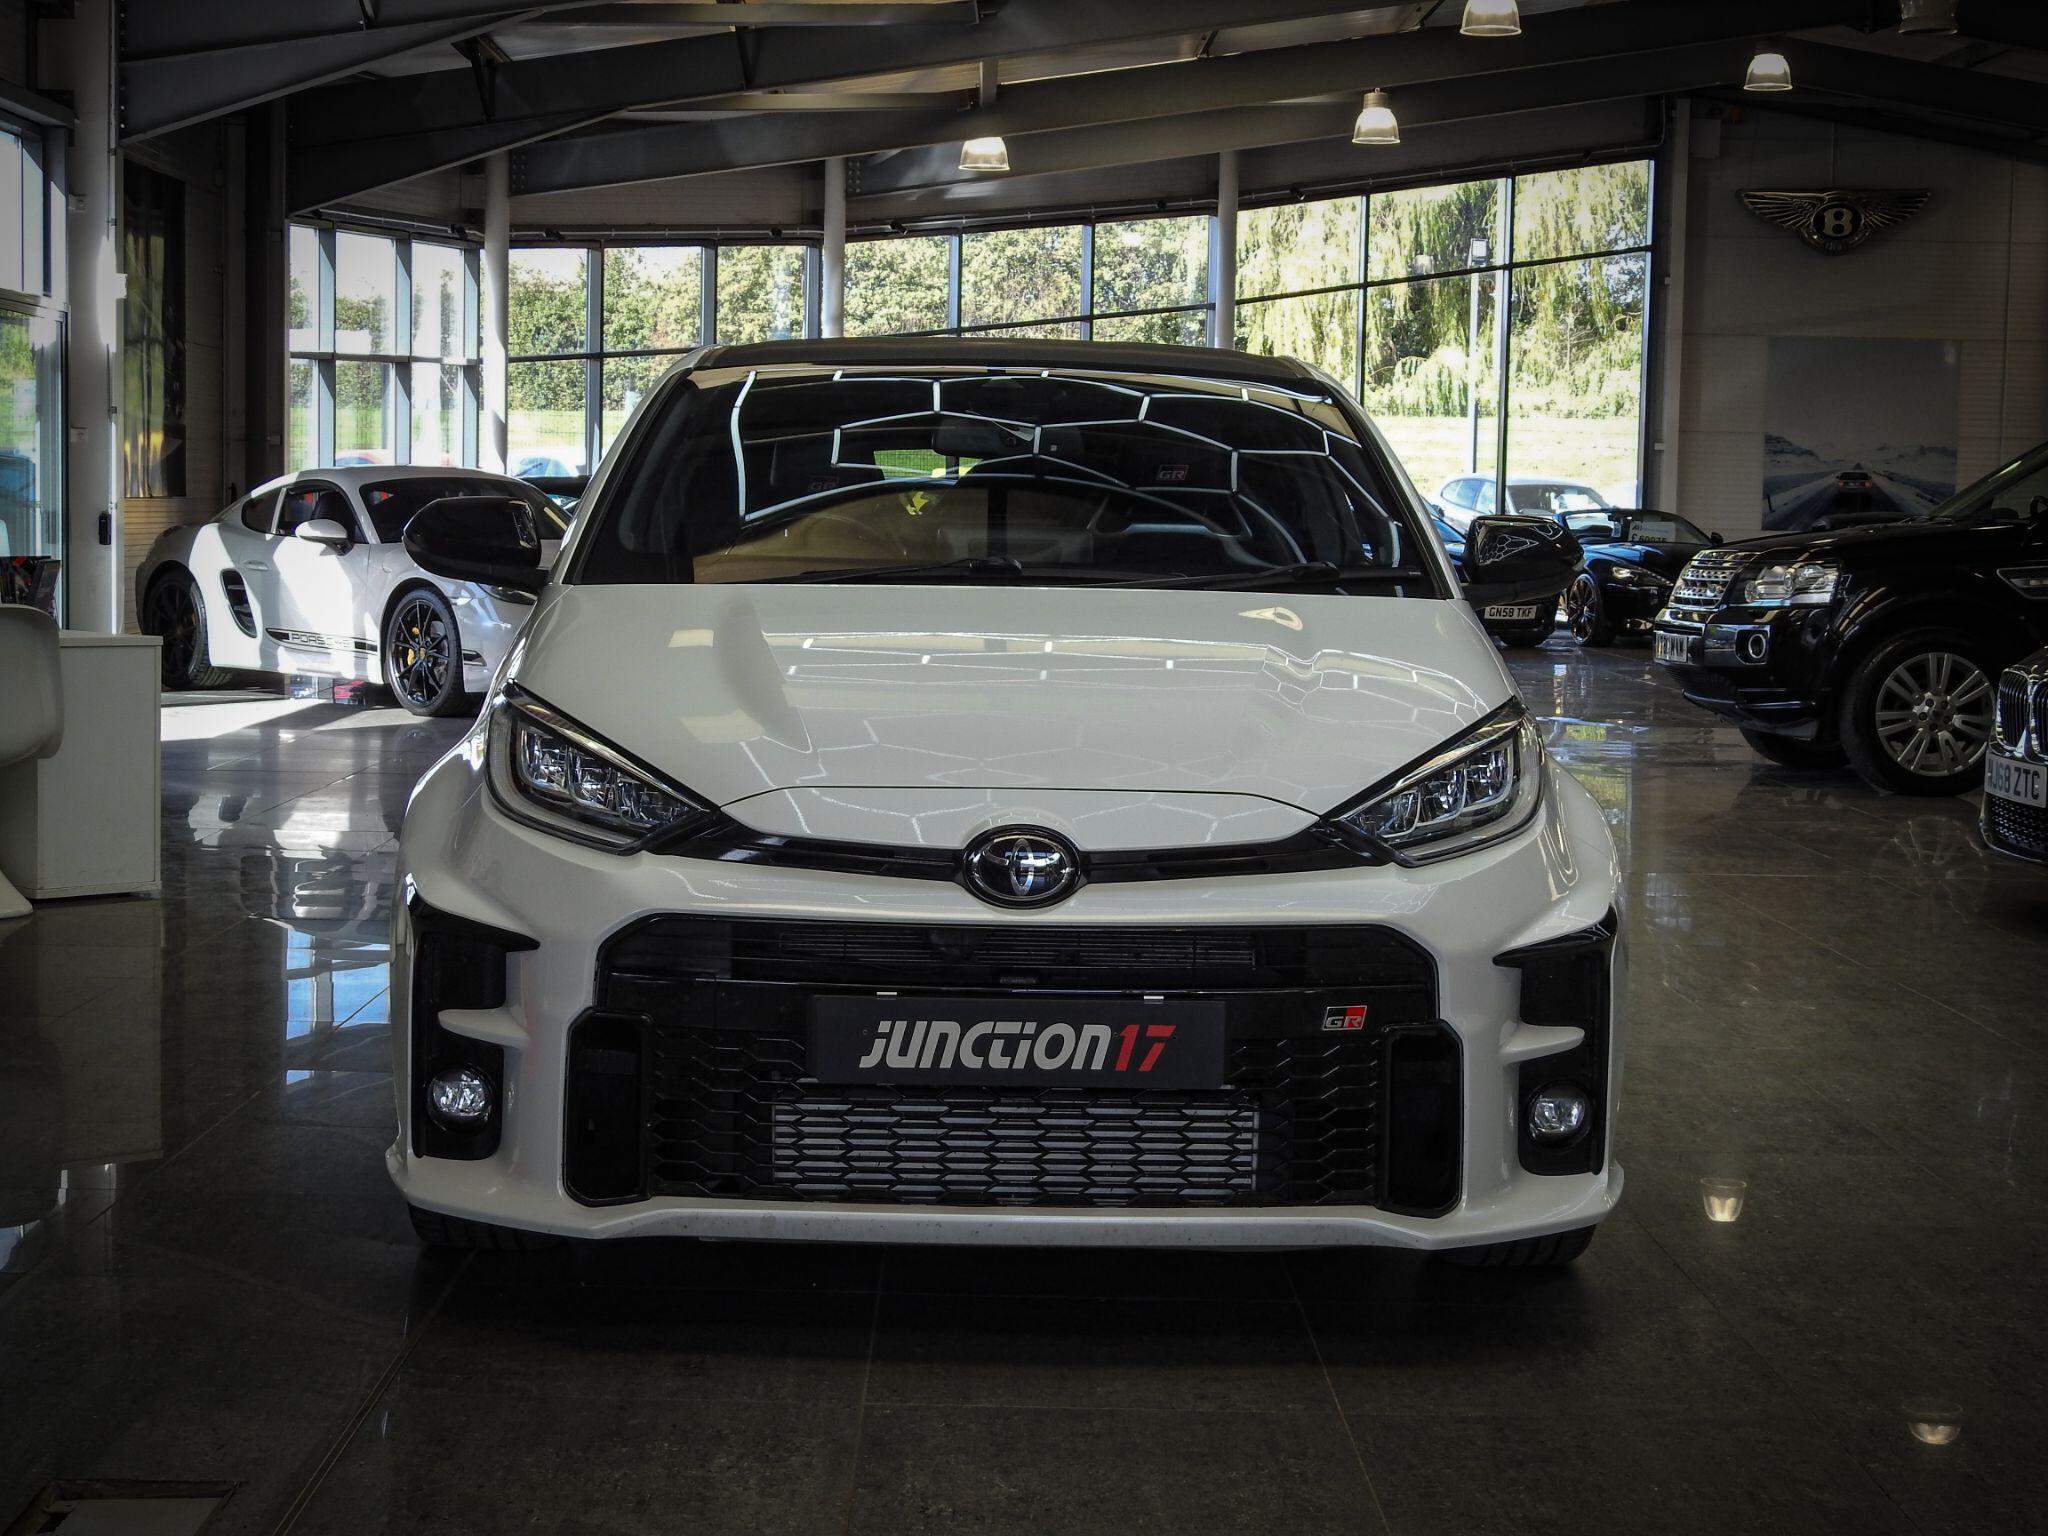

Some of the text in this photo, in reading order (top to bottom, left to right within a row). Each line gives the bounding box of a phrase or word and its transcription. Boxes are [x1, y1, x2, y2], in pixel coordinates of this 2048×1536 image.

[1489, 606, 1534, 618] GN58 TKF
[2013, 766, 2040, 800] ZTC
[1325, 1015, 1363, 1029] GR
